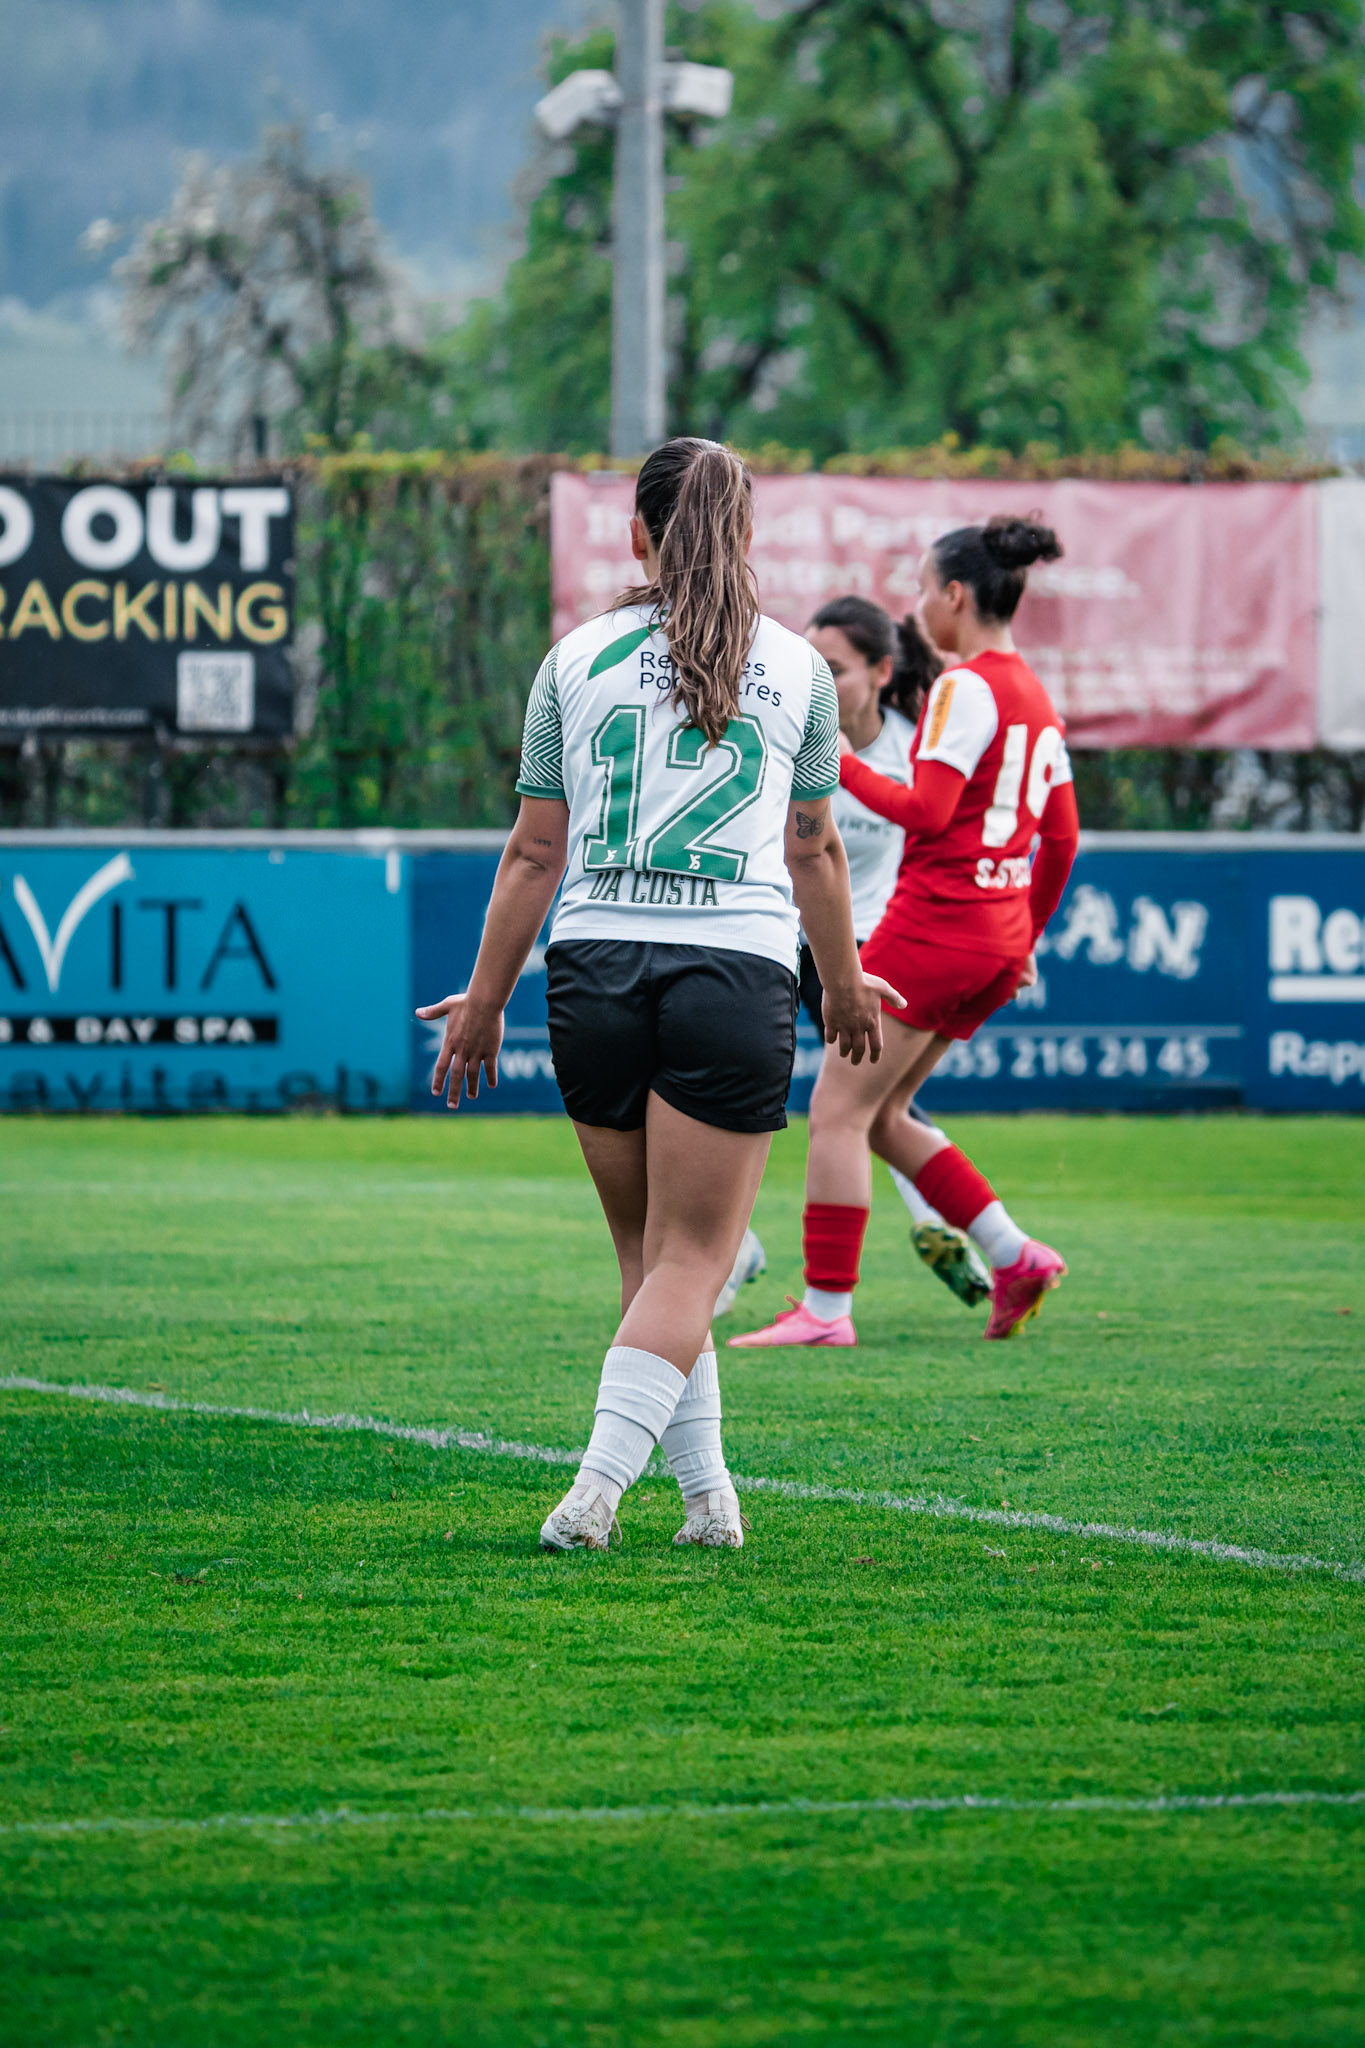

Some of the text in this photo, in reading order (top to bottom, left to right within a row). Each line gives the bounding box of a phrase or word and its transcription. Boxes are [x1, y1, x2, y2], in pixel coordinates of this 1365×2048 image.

[61, 485, 289, 572] OUT
[0, 579, 288, 644] ACKING
[584, 704, 767, 883] 12
[631, 871, 720, 906] COSTA
[1268, 894, 1365, 973] Re
[75, 1016, 156, 1044] DAY
[174, 1016, 255, 1044] SPA
[1268, 1030, 1365, 1086] Rap
